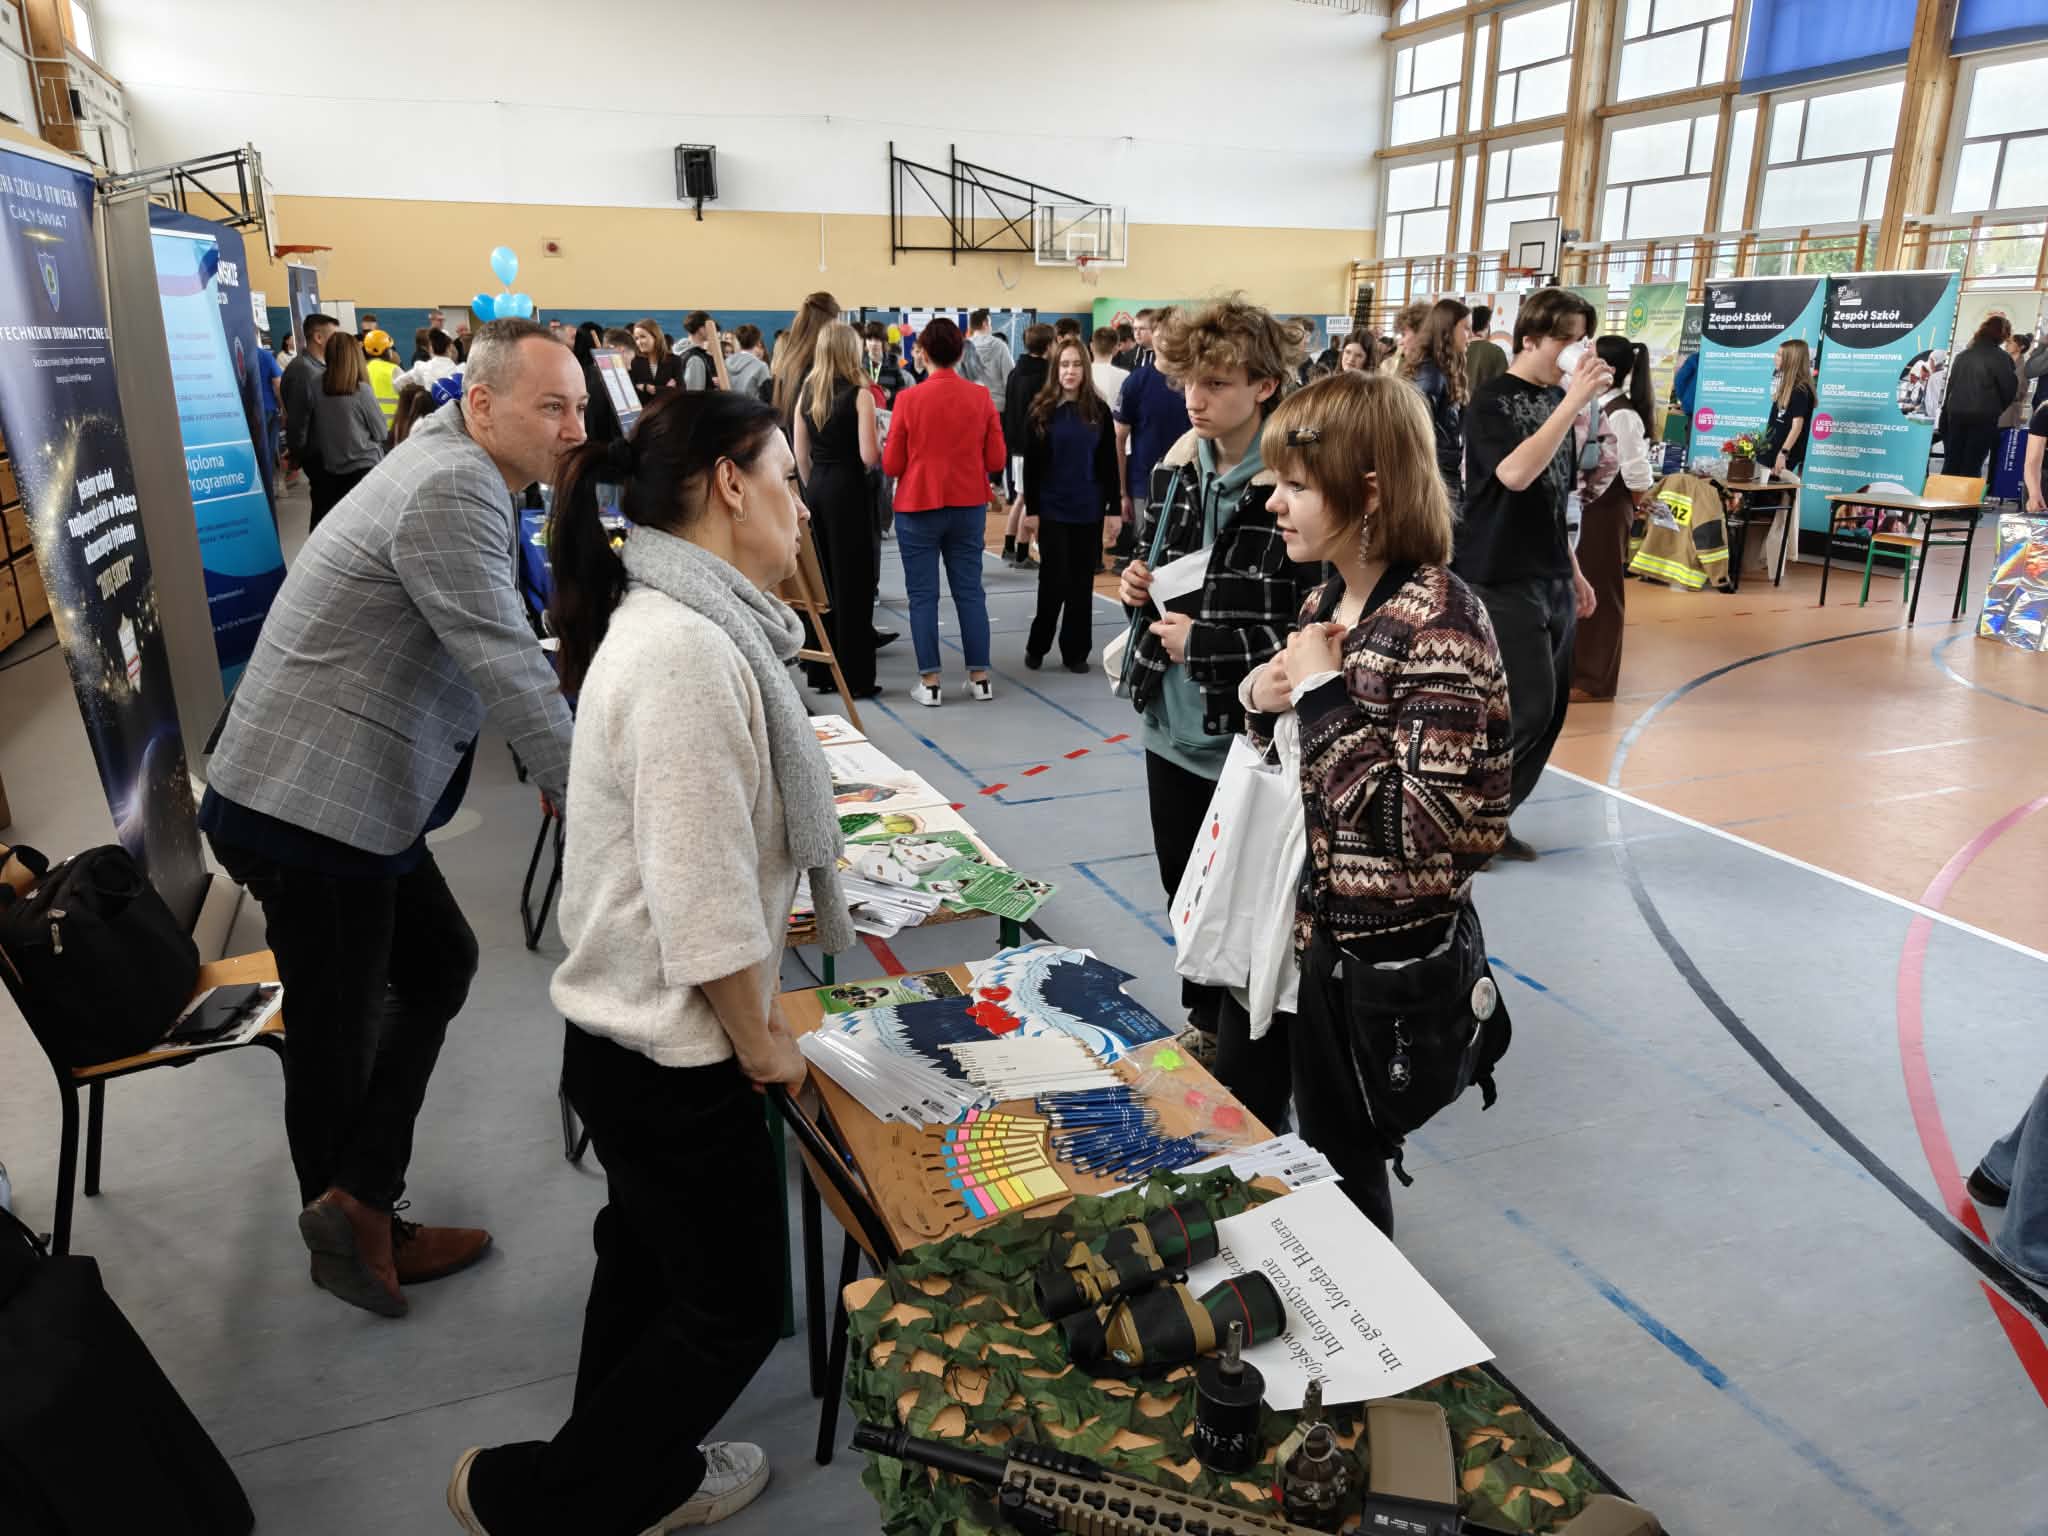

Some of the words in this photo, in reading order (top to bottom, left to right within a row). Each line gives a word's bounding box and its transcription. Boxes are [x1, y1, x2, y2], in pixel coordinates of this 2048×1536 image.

[1709, 312, 1743, 323] Zespół
[1744, 311, 1772, 322] Szkół
[1833, 310, 1868, 322] Zespół
[1870, 309, 1900, 321] Szkół
[0, 325, 52, 340] TECHNIKUM
[185, 454, 225, 475] iploma
[189, 472, 246, 495] rogramme
[112, 493, 138, 516] Polsce
[1270, 1216, 1316, 1270] Hallera
[1310, 1263, 1352, 1312] Józefa
[1261, 1256, 1345, 1359] Informatyczne
[1349, 1308, 1383, 1343] gen.
[1282, 1331, 1333, 1385] Wojskow
[1375, 1341, 1404, 1375] im.
